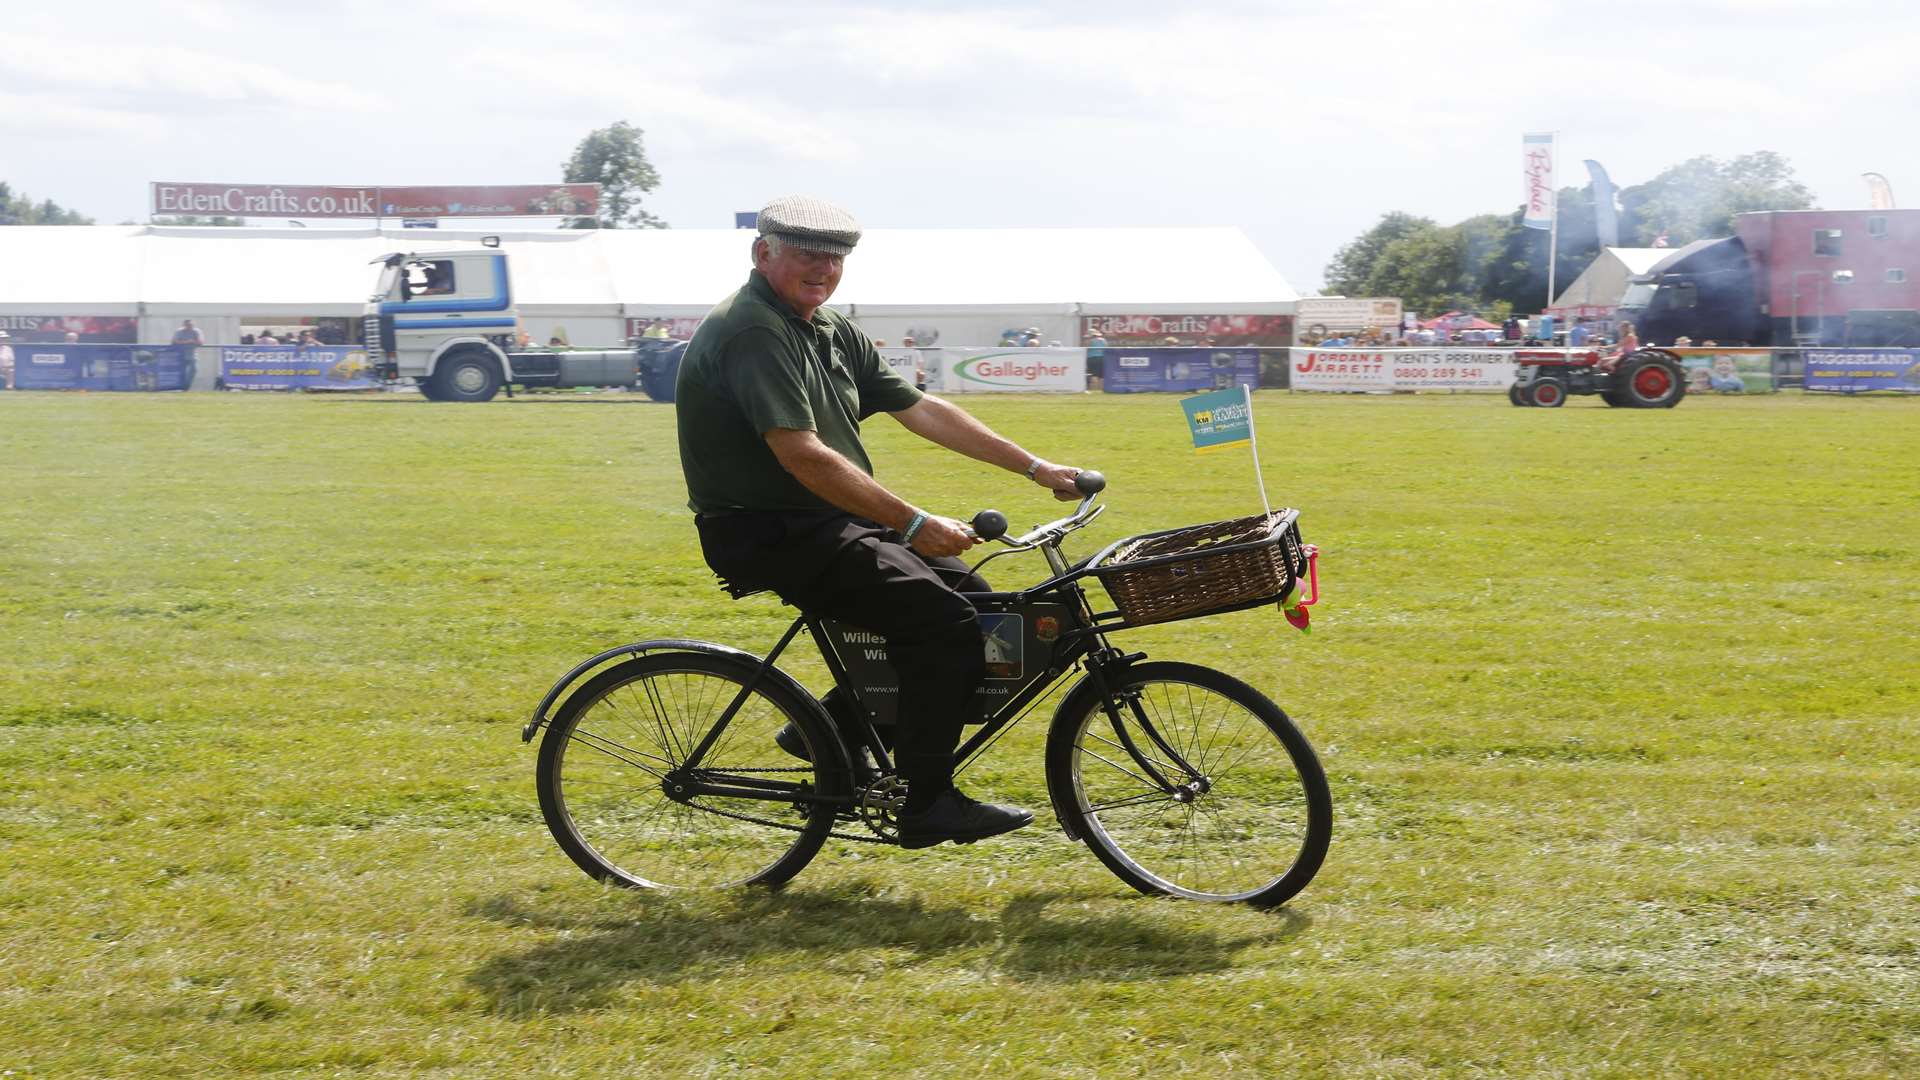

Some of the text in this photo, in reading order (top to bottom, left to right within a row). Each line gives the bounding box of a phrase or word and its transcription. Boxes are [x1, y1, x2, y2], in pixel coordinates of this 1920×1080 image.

[160, 184, 373, 215] EdenCrafts.co.uk
[0, 317, 39, 330] afts
[1145, 316, 1208, 334] Crafts
[225, 351, 336, 363] DIGGERLAND
[1393, 354, 1441, 364] KENT'S
[1446, 354, 1503, 364] PREMIER
[1808, 353, 1912, 365] DIGGERLAND
[976, 361, 1070, 380] Gallagher
[1394, 368, 1482, 378] 0800 289 541
[843, 632, 887, 644] Willes
[864, 685, 899, 694] www.wi
